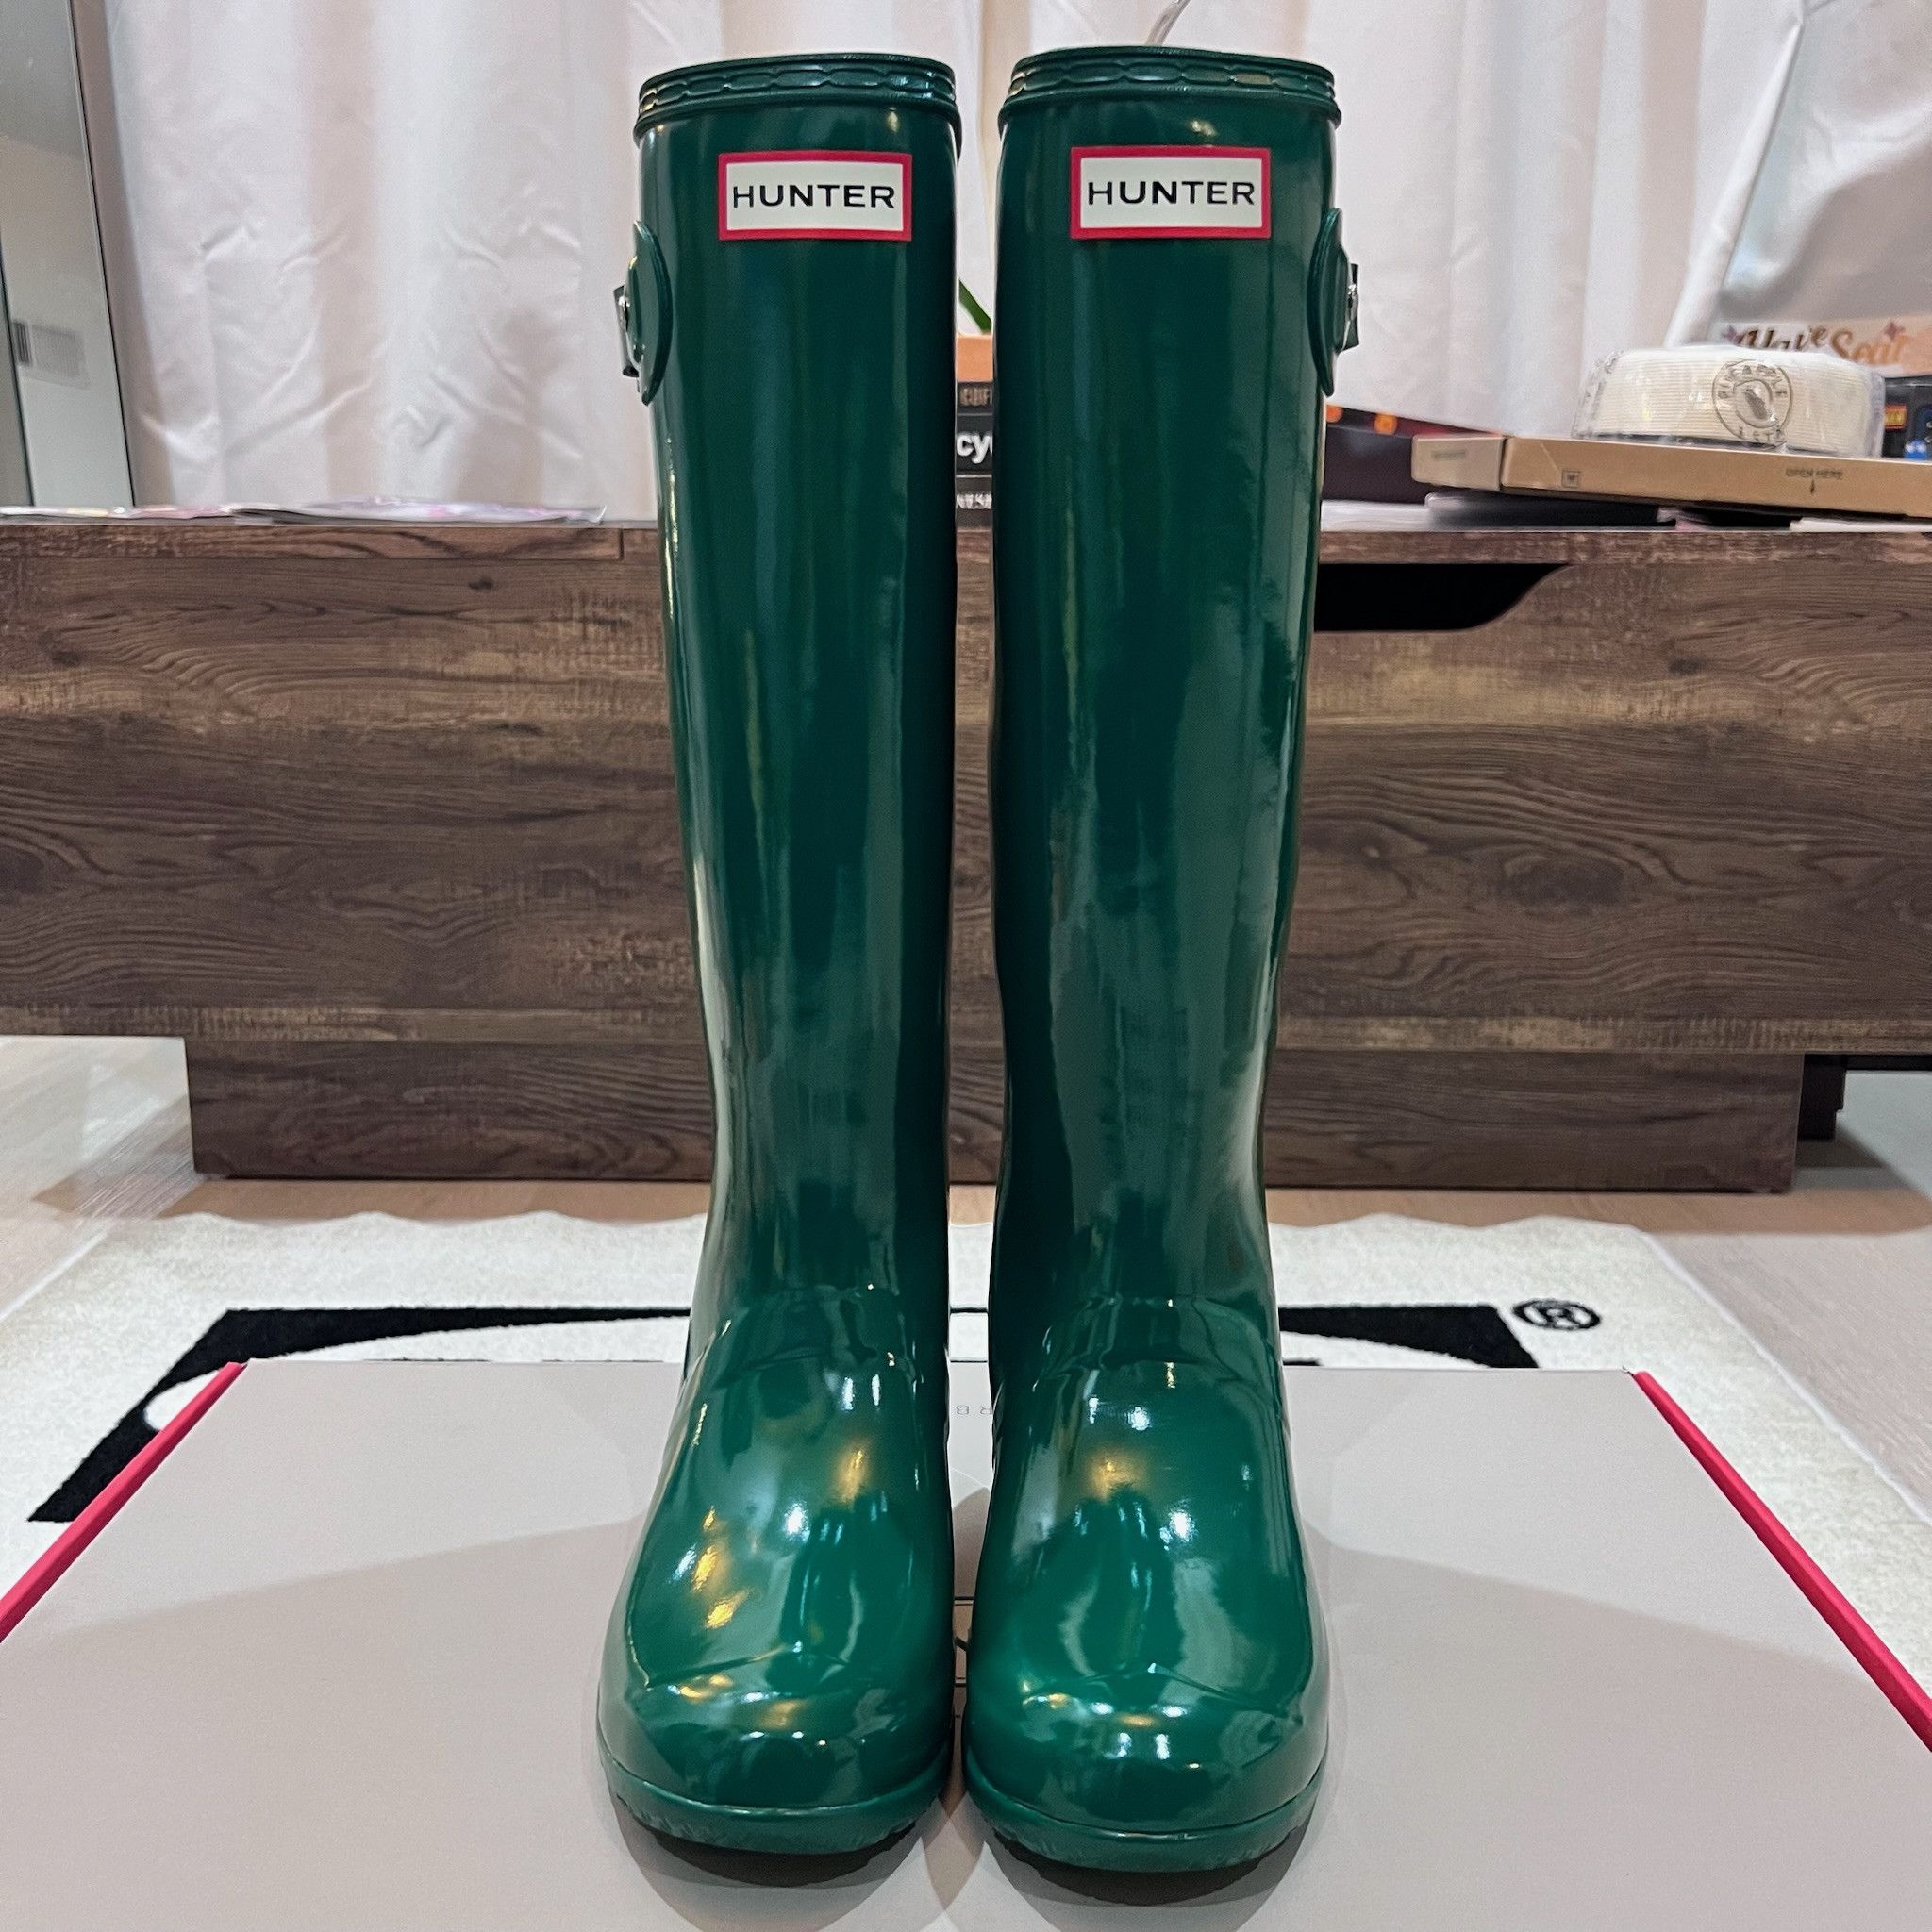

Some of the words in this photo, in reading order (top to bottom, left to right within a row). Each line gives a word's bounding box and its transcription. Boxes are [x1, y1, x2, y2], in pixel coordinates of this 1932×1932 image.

[733, 184, 895, 208] HUNTER
[1088, 180, 1256, 205] HUNTER
[957, 434, 992, 464] cy
